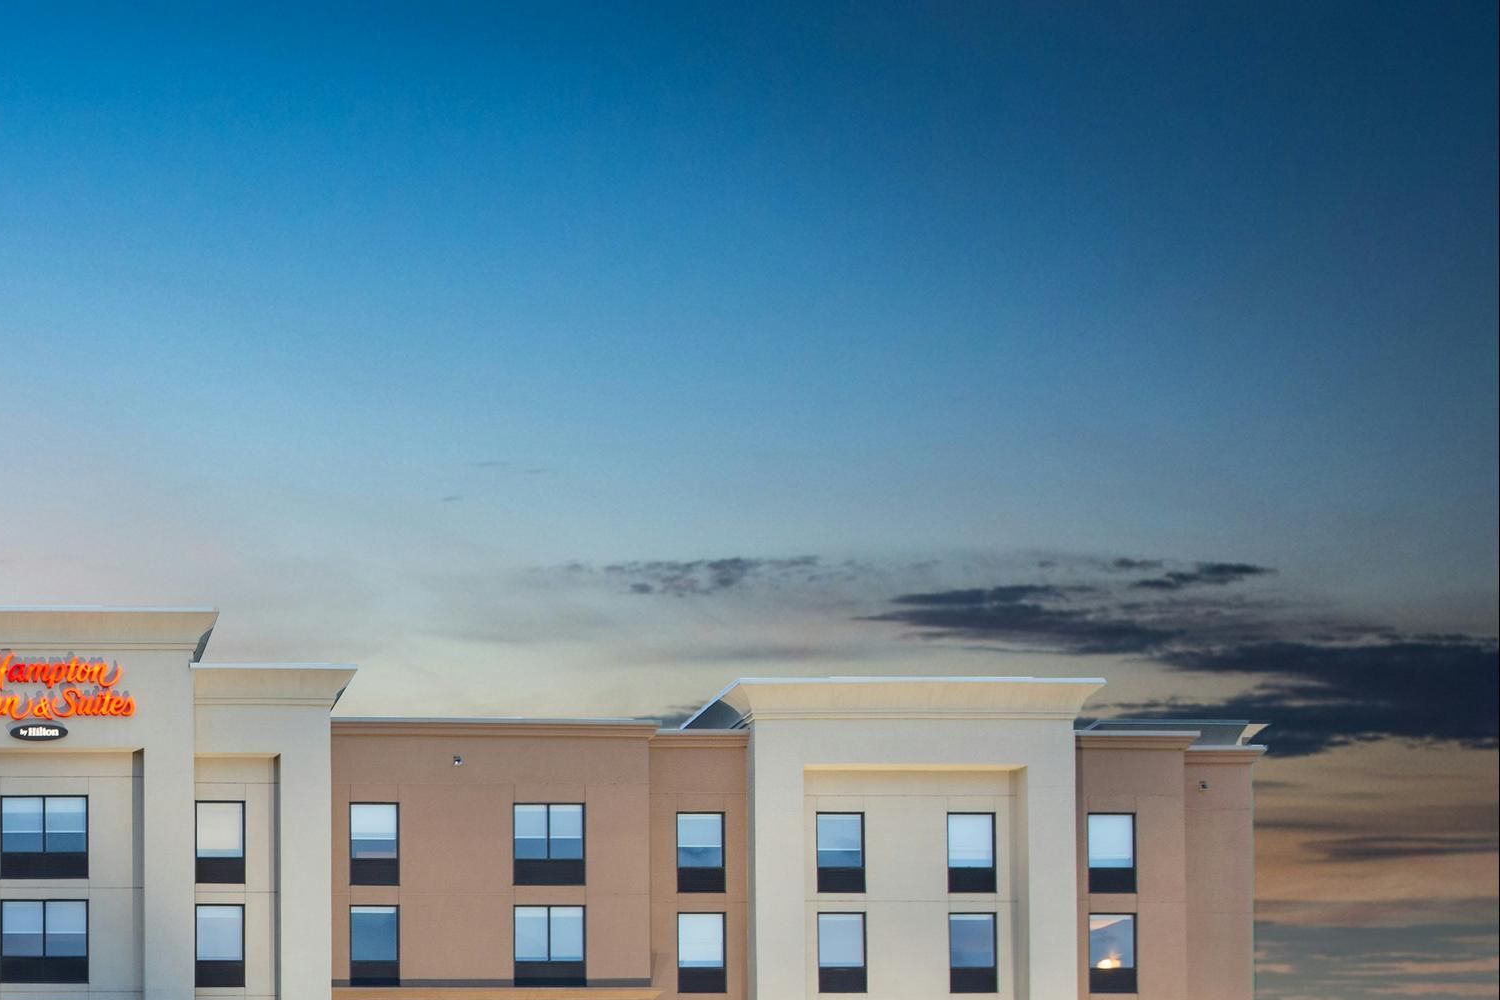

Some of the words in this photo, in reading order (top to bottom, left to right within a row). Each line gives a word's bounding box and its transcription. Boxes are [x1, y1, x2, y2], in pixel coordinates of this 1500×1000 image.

[34, 697, 54, 719] &
[51, 688, 136, 719] Suites
[19, 728, 28, 737] by
[28, 726, 60, 737] Hilton
